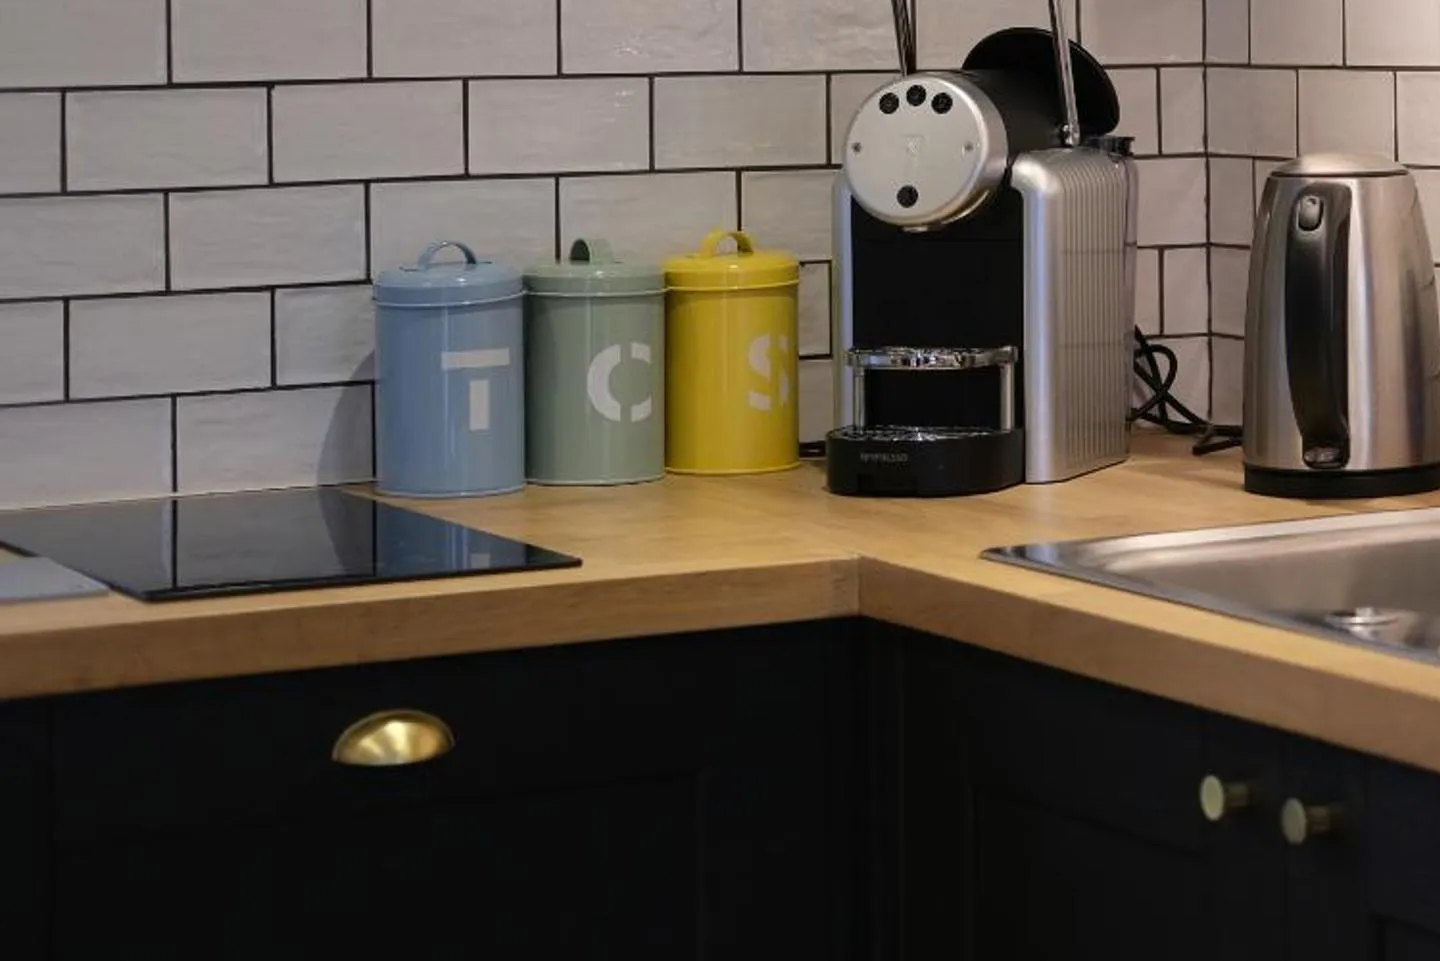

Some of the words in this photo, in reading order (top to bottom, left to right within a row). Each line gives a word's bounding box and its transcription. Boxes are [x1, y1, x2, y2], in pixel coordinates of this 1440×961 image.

[441, 348, 510, 431] T
[587, 342, 652, 422] C
[748, 333, 790, 411] S
